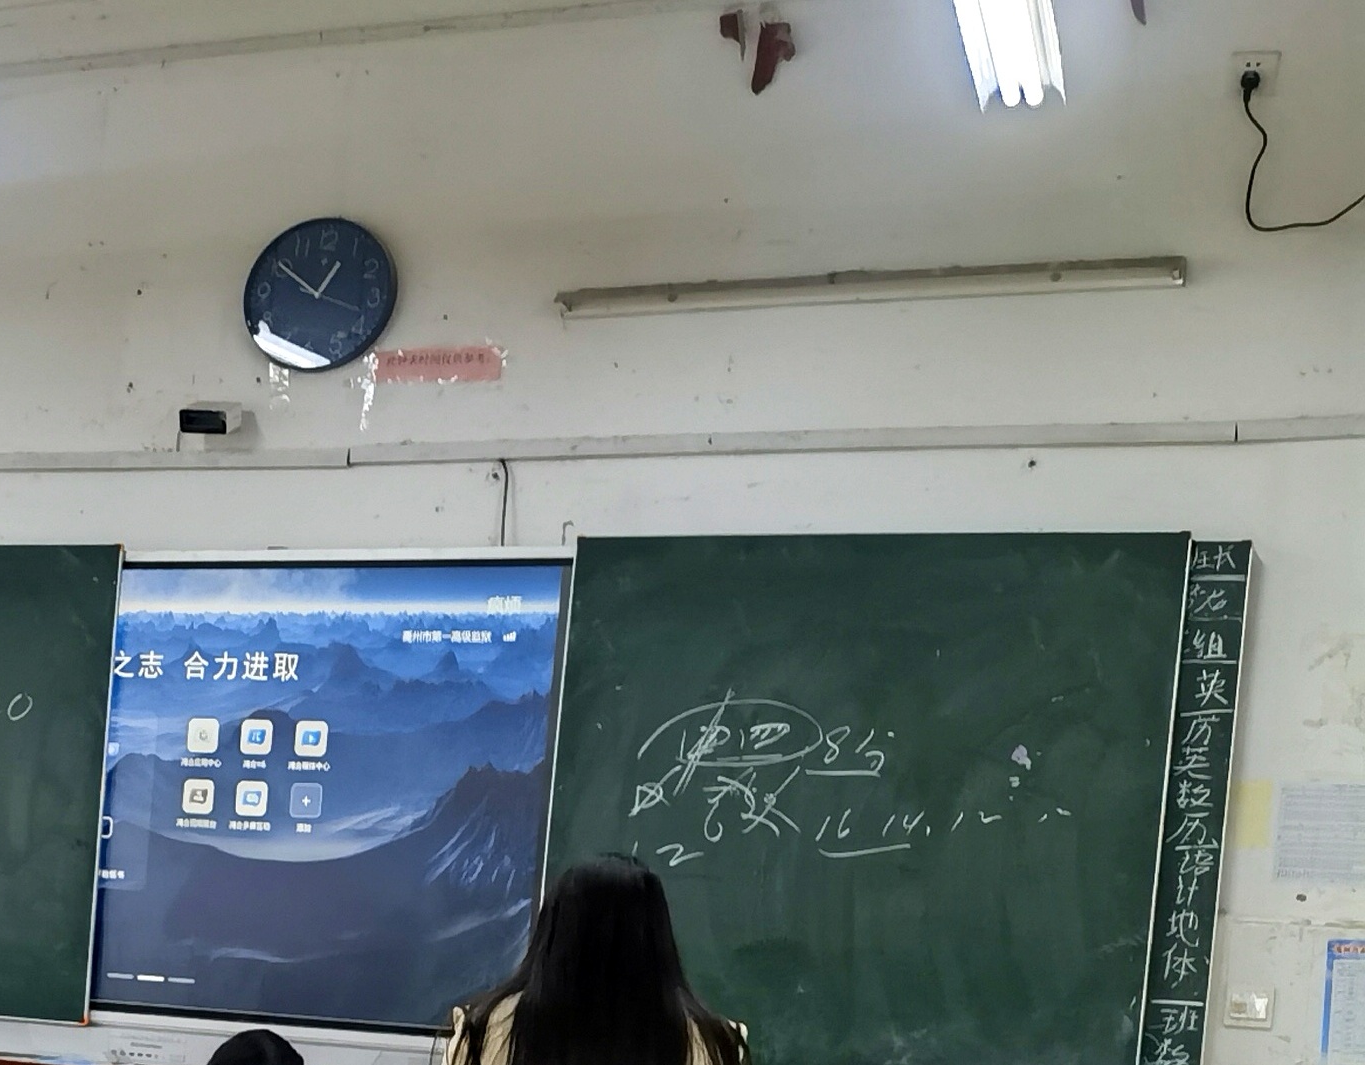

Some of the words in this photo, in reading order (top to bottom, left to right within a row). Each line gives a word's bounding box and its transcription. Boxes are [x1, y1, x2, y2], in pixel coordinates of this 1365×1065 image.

[114, 651, 165, 680] 之志
[183, 651, 300, 682] 合力进取
